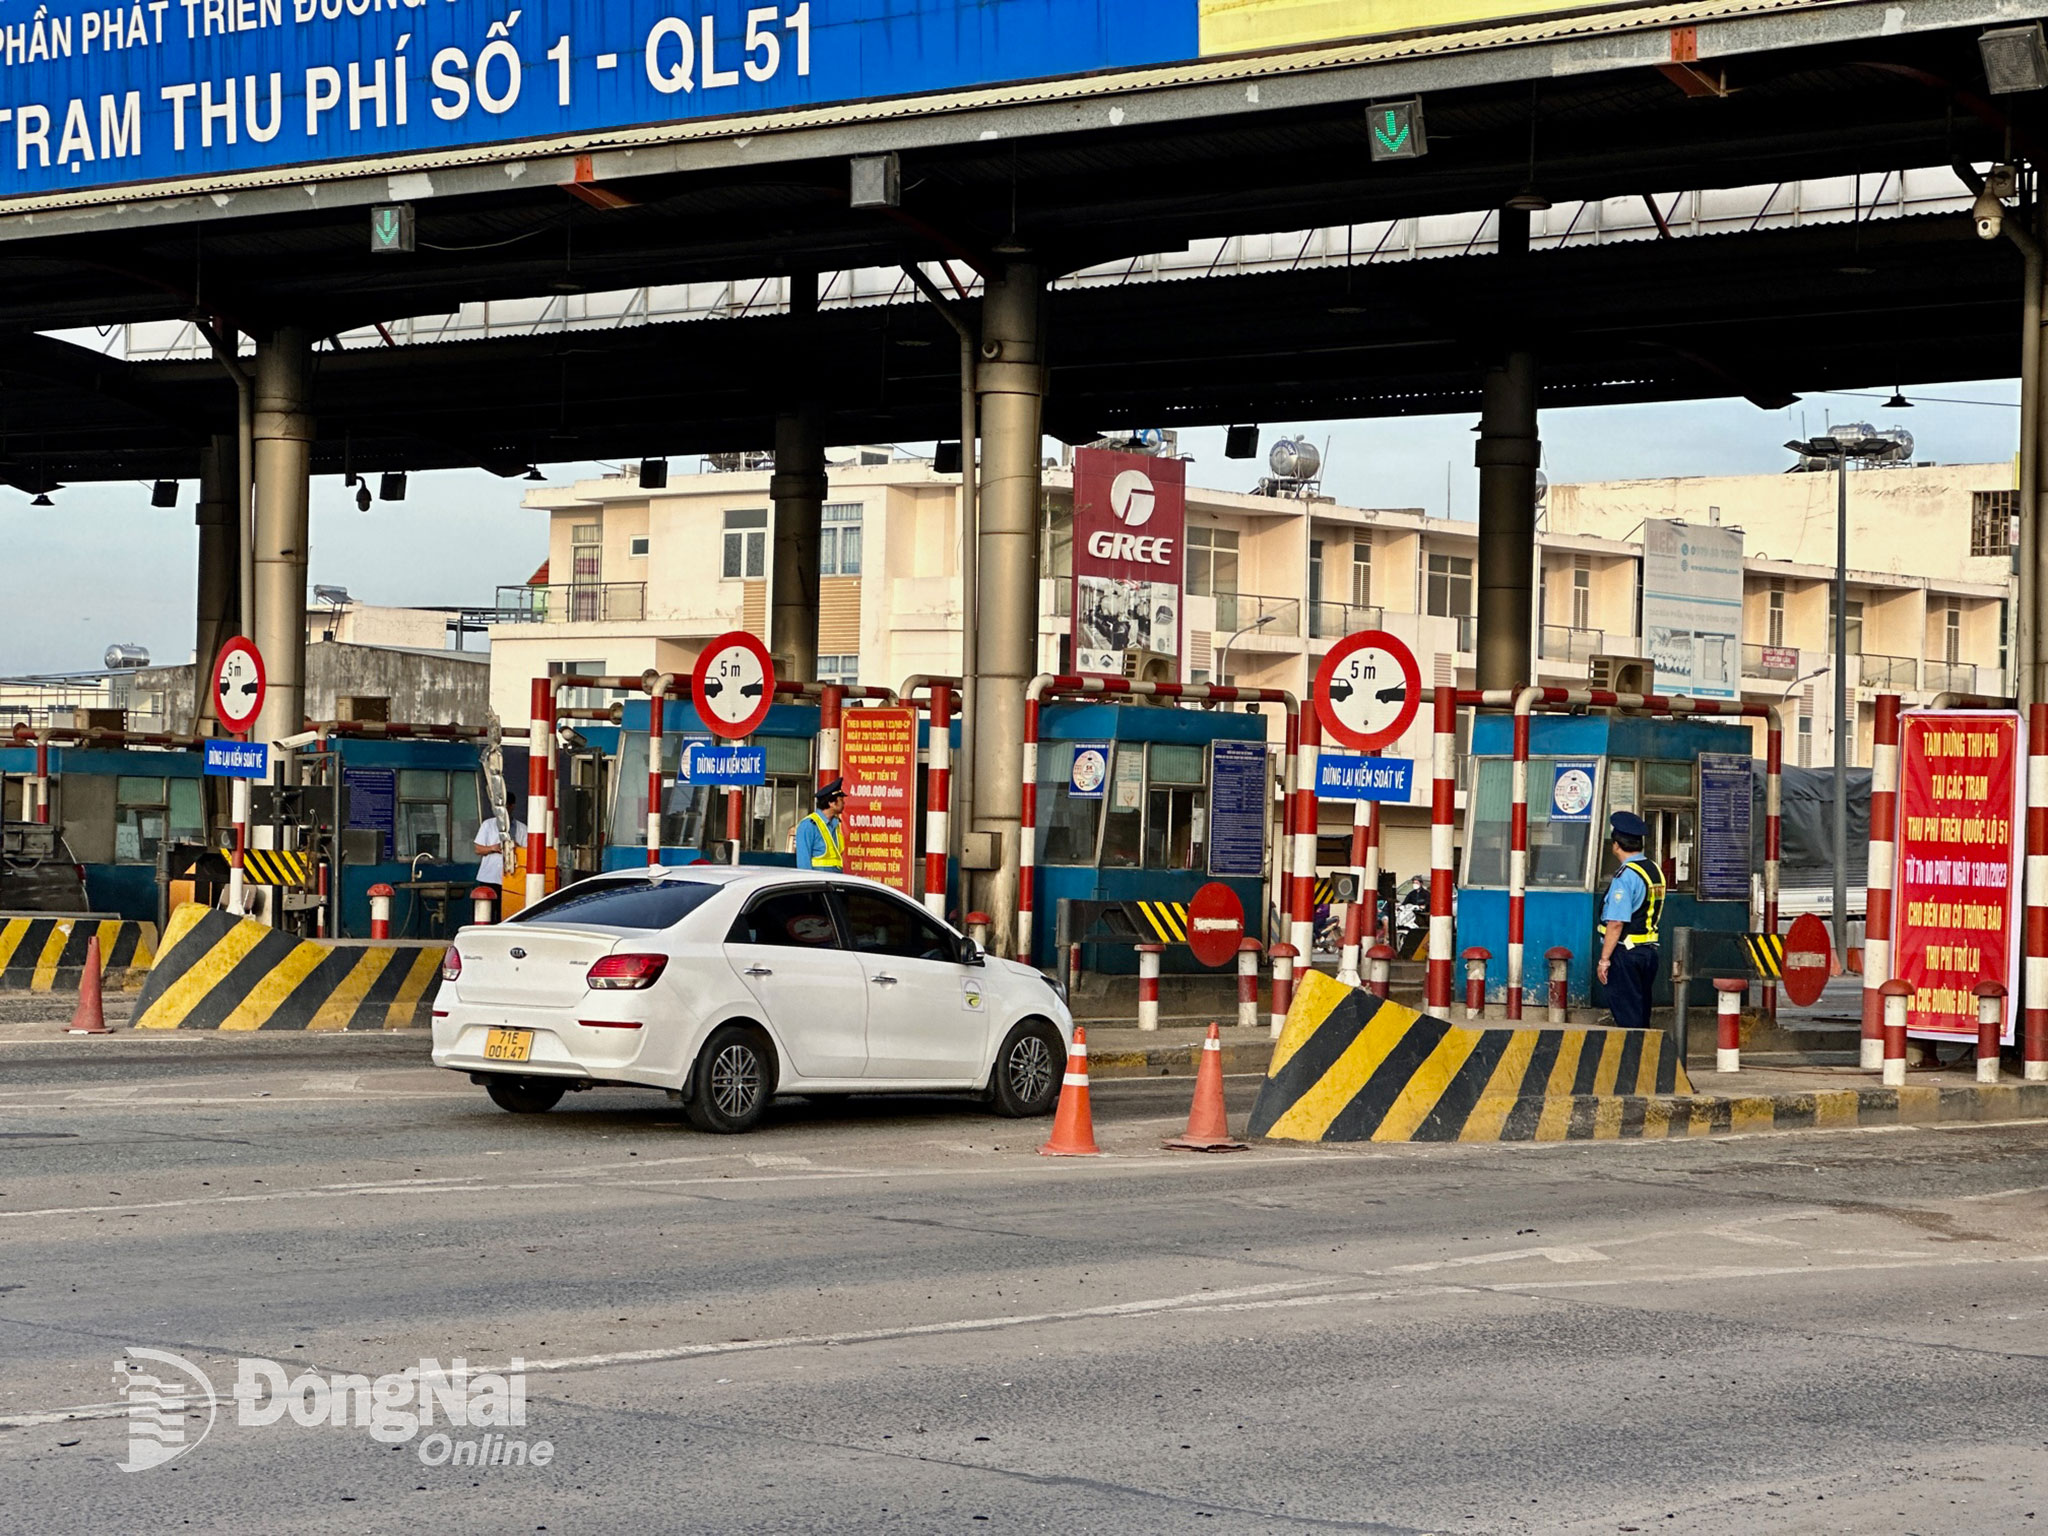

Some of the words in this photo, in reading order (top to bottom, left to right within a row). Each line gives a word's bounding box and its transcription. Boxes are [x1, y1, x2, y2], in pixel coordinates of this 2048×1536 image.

[82, 0, 169, 54] PHÁT
[161, 72, 282, 151] THU
[306, 33, 411, 136] PHÍ
[431, 10, 522, 120] SỐ
[547, 35, 570, 106] 1
[645, 2, 809, 94] QL51
[1088, 531, 1174, 565] GREE
[228, 661, 232, 677] 5
[720, 661, 727, 677] 5
[730, 665, 741, 677] m
[1351, 661, 1359, 679] 5
[1363, 666, 1376, 679] m
[208, 746, 222, 765] DỪNG
[222, 751, 230, 768] LẠI
[231, 746, 242, 767] KIỂM
[243, 749, 255, 767] SOÁT
[256, 750, 263, 768] VÉ
[1923, 732, 1941, 762] TẠM
[1943, 727, 1965, 757] DỪNG
[1967, 733, 1982, 757] THU
[1984, 728, 1998, 757] PHÍ
[696, 753, 716, 774] DỪNG
[716, 757, 725, 777] LẠI
[726, 751, 740, 774] KIỂM
[741, 753, 753, 773] SOÁT
[753, 753, 761, 773] VÉ
[1322, 763, 1341, 785] DỪNG
[1342, 768, 1353, 790] LẠI
[1354, 761, 1373, 787] KIỂM
[1373, 765, 1394, 788] SOÁT
[1395, 766, 1405, 789] VÉ
[850, 784, 887, 797] 4.000.000
[1932, 775, 1945, 805] TẠI
[1946, 770, 1963, 799] CÁC
[1965, 776, 1988, 806] TRẠM
[849, 815, 886, 827] 6.000.000
[1908, 817, 1923, 841] THU
[1924, 812, 1939, 841] PHÍ
[1940, 813, 1961, 842] TRÊN
[1963, 810, 1985, 845] QUỐC
[1986, 814, 1997, 850] LỘ
[1999, 820, 2008, 844] 51
[1906, 854, 1915, 884] TỪ
[1934, 855, 1951, 885] PHÚT
[1952, 856, 1970, 886] NGÀY
[1972, 862, 2007, 888] 13/01/2023
[1908, 902, 1922, 926] CHO
[1923, 895, 1938, 927] ĐẾN
[1939, 903, 1952, 928] KHI
[1952, 899, 1962, 929] CÓ
[1963, 900, 1986, 930] THÔNG
[1987, 900, 2002, 931] BÁO
[1926, 945, 1940, 970] THU
[1940, 941, 1953, 971] PHÍ
[1954, 939, 1968, 972] TRỞ
[1968, 948, 1980, 978] LẠI
[1917, 988, 1931, 1018] CỤC
[1932, 983, 1956, 1014] ĐƯỜNG
[1957, 985, 1968, 1020] BỘ
[488, 1046, 525, 1059] 001.47
[499, 1032, 519, 1045] 71E
